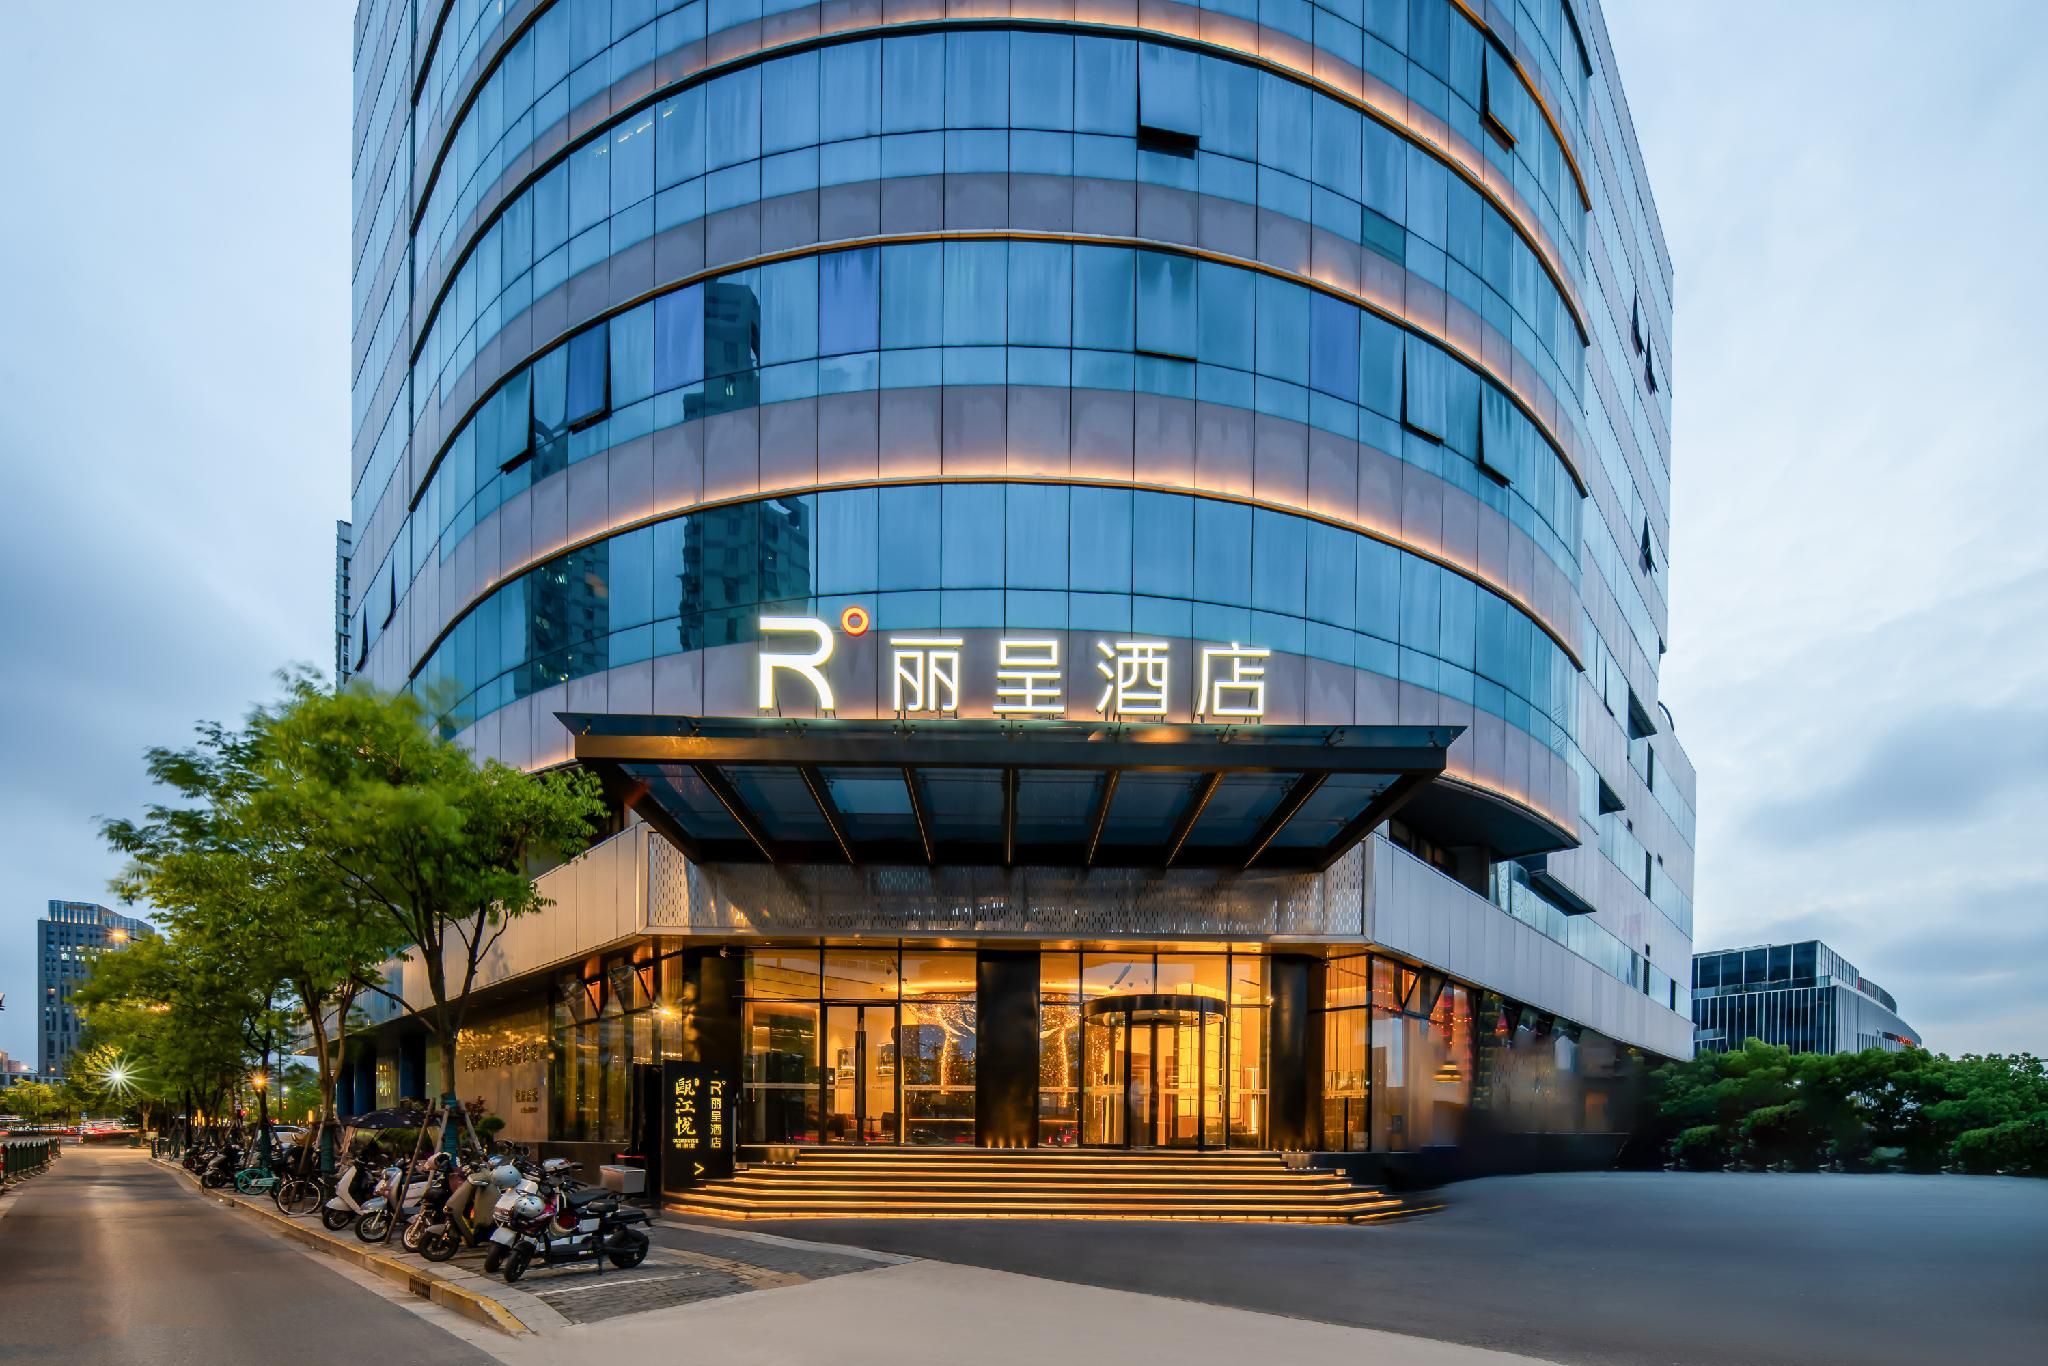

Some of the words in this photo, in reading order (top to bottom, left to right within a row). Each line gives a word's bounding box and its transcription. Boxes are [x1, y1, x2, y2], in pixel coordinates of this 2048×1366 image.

[890, 637, 1271, 716] 丽呈酒店
[709, 1097, 722, 1149] 丽呈酒店
